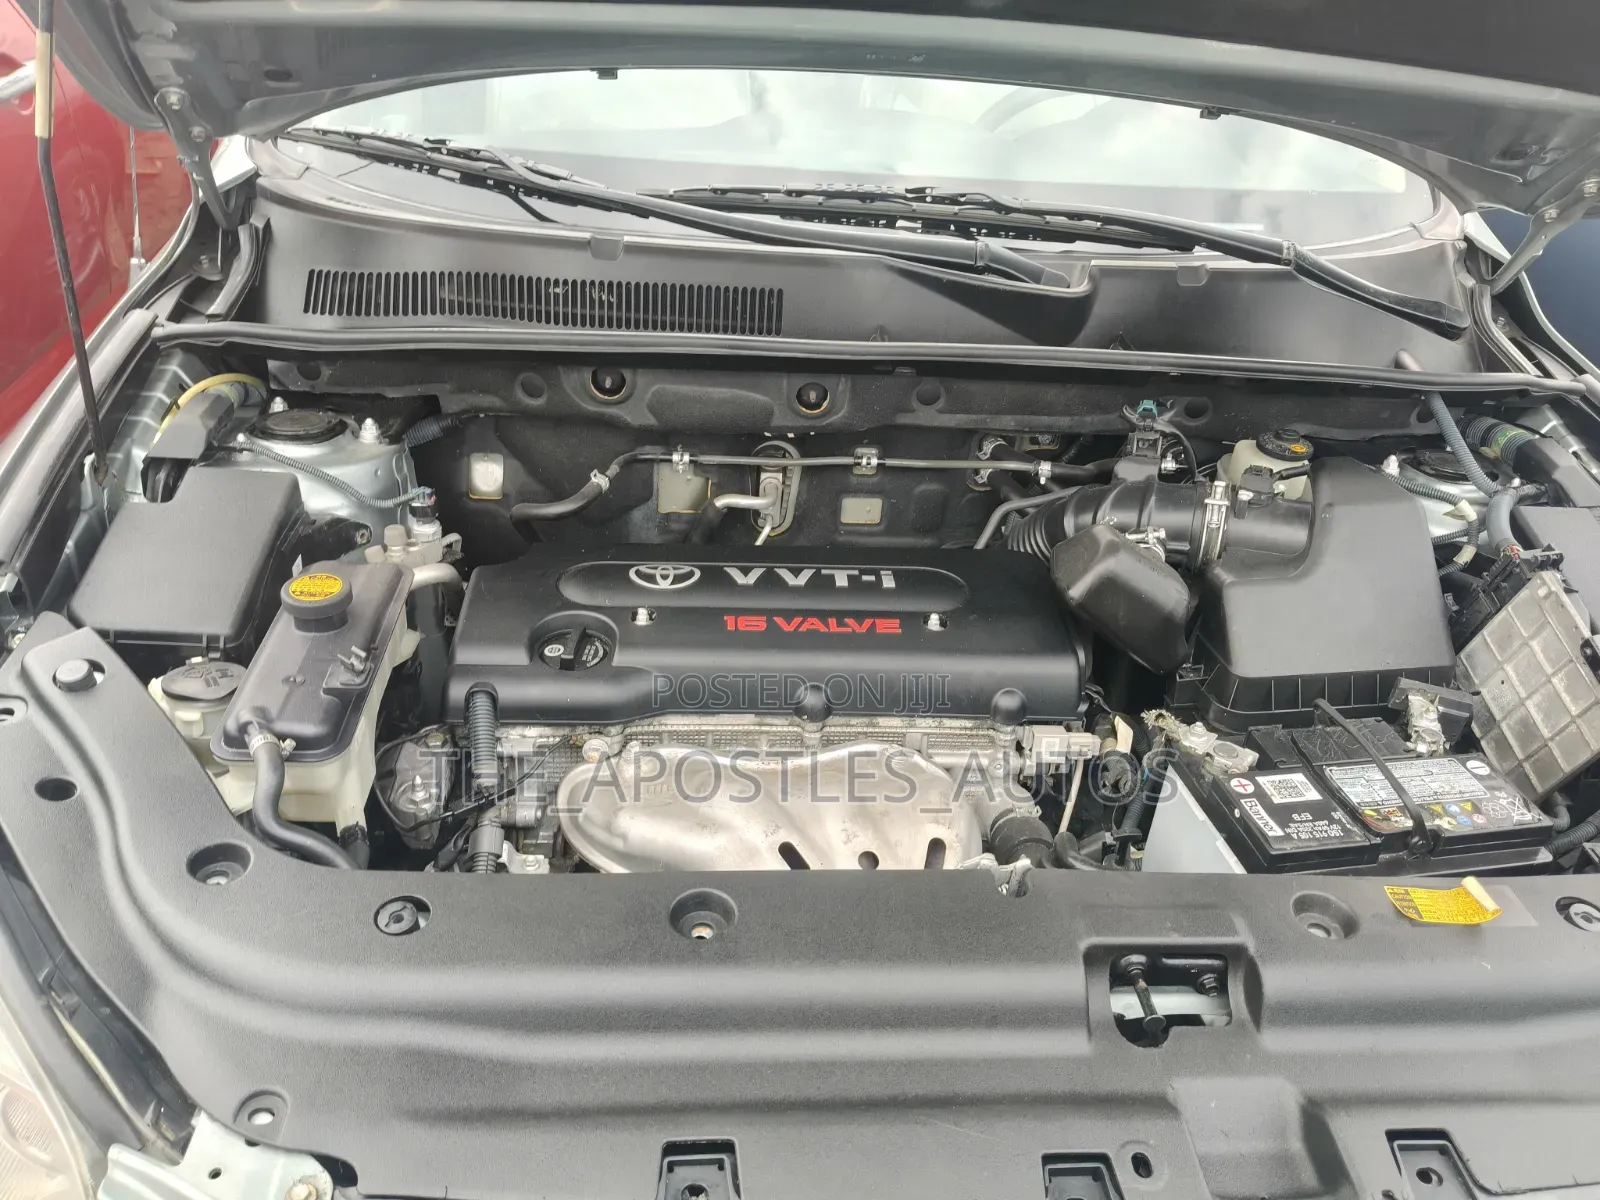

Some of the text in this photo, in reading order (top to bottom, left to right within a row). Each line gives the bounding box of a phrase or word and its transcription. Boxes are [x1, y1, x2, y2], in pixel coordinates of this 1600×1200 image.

[724, 567, 896, 589] VVT-i
[723, 614, 903, 634] 16 VALVE
[1243, 800, 1278, 834] Banner
[1291, 812, 1313, 821] EFB
[1290, 832, 1298, 840] A
[1298, 831, 1313, 840] 105
[1312, 830, 1328, 838] 915
